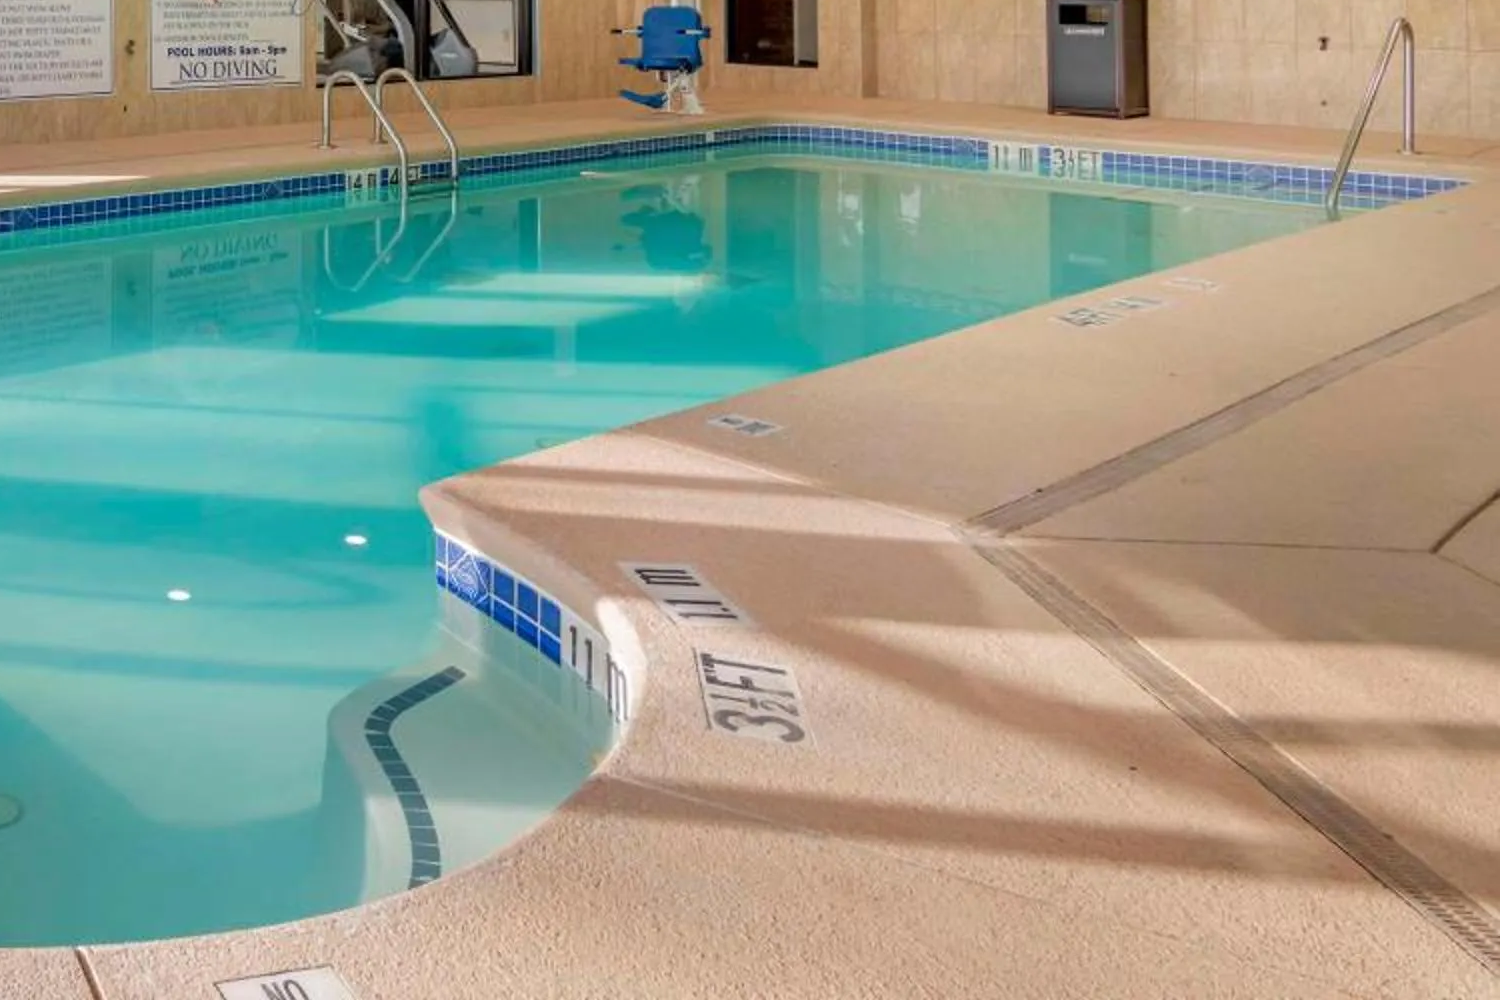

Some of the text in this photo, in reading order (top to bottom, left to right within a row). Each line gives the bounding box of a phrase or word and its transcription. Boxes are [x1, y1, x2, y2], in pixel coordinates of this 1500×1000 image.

[167, 47, 195, 57] POOL
[197, 45, 237, 57] HOURS:
[179, 58, 278, 81] NO DIVING
